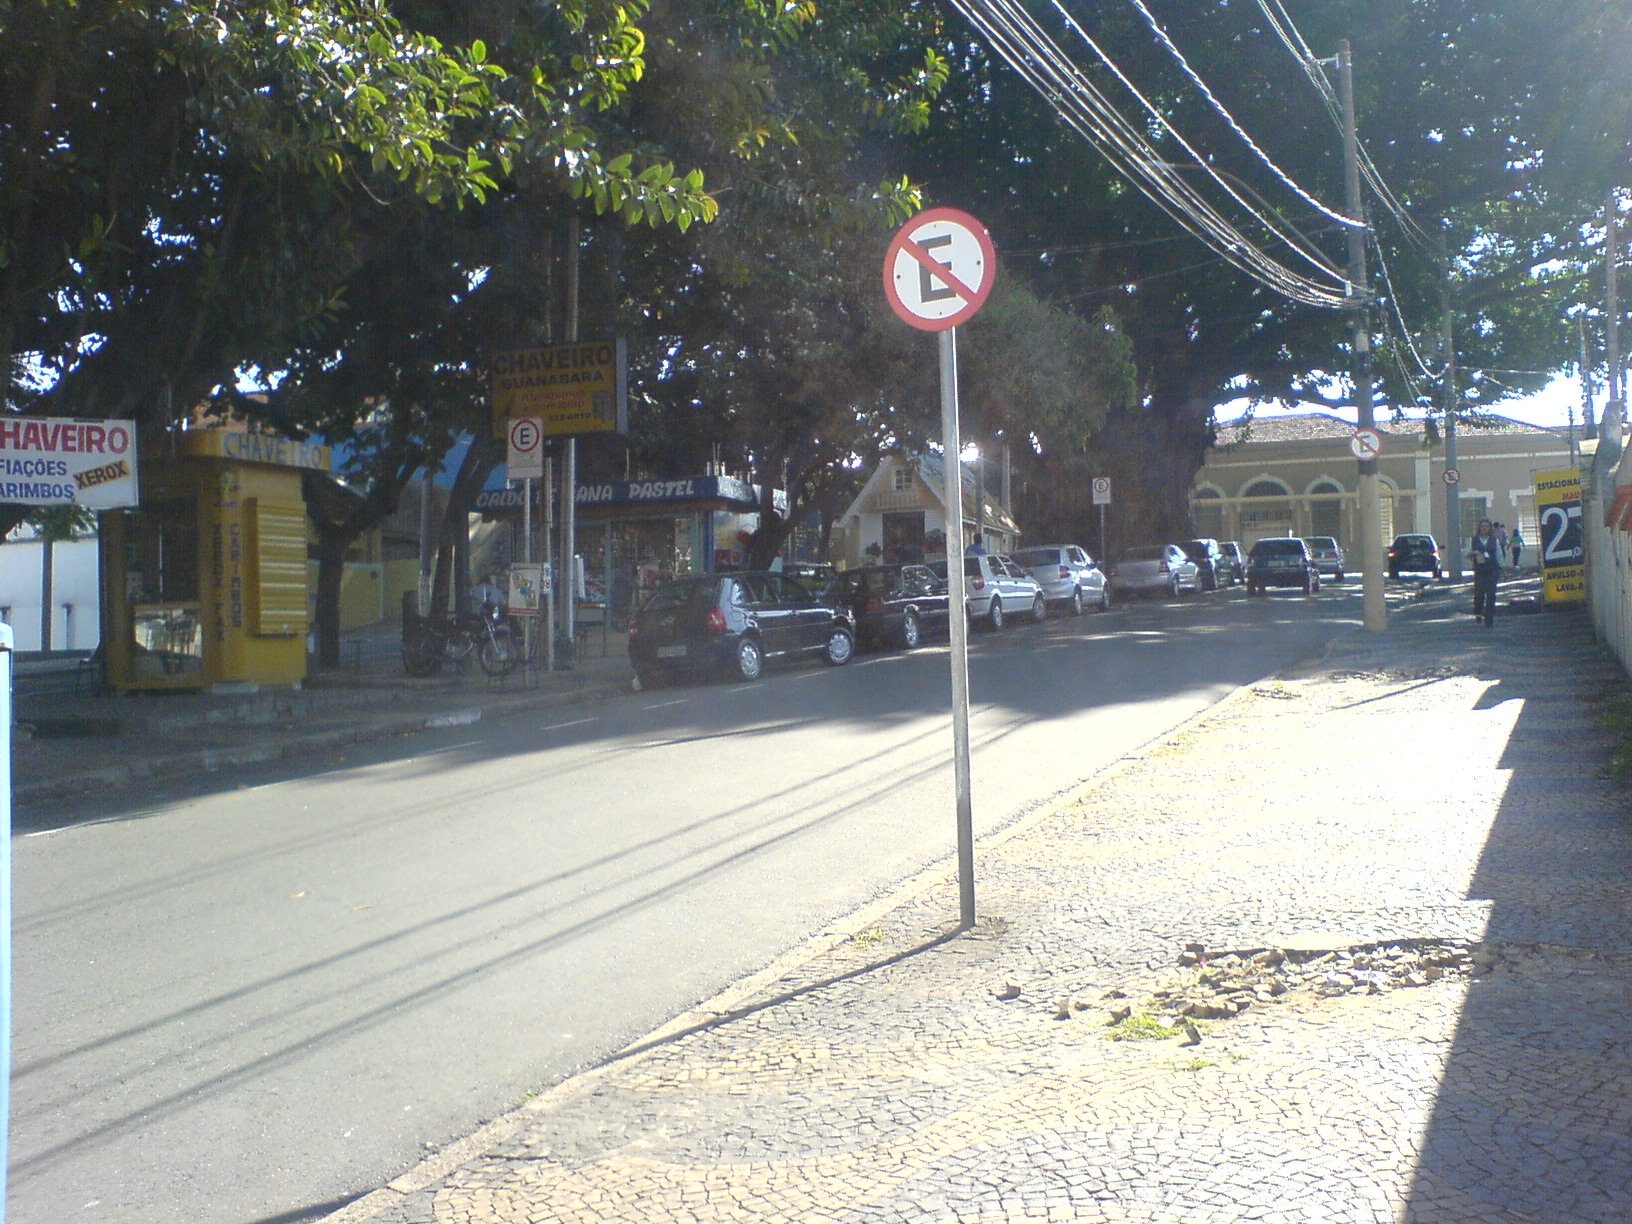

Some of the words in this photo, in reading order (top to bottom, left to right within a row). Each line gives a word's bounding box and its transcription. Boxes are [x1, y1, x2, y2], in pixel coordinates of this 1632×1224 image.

[918, 234, 957, 304] E
[494, 345, 611, 374] CHAVEIRO
[502, 370, 604, 390] GUANABARA
[0, 420, 129, 454] HAVEIRO
[520, 427, 530, 445] E
[73, 460, 128, 490] XEROX
[629, 480, 694, 499] PASTEL
